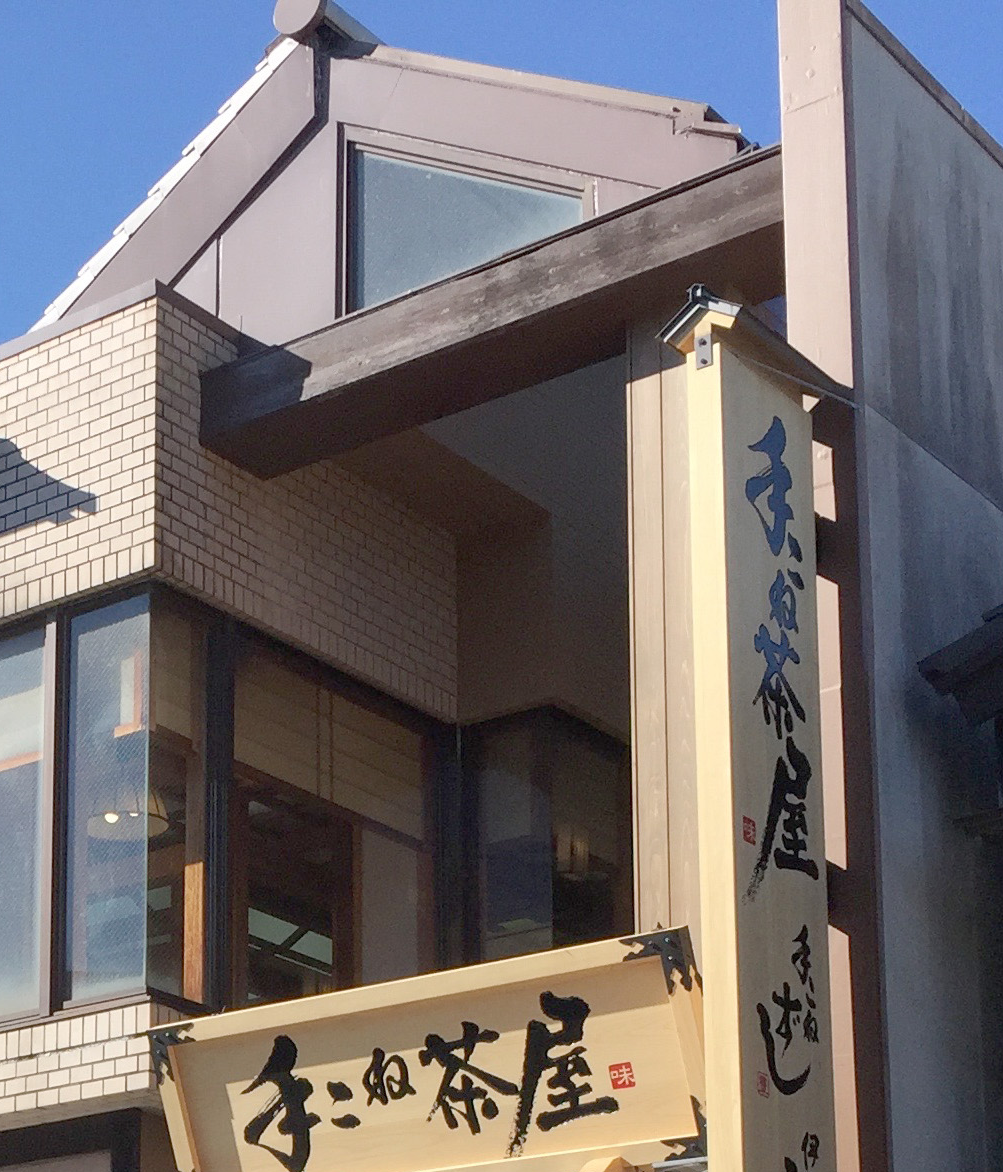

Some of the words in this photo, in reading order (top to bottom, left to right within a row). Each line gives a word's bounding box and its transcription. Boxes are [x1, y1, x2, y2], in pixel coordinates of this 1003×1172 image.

[743, 416, 819, 903] 手こね茶屋
[609, 1062, 636, 1089] 味
